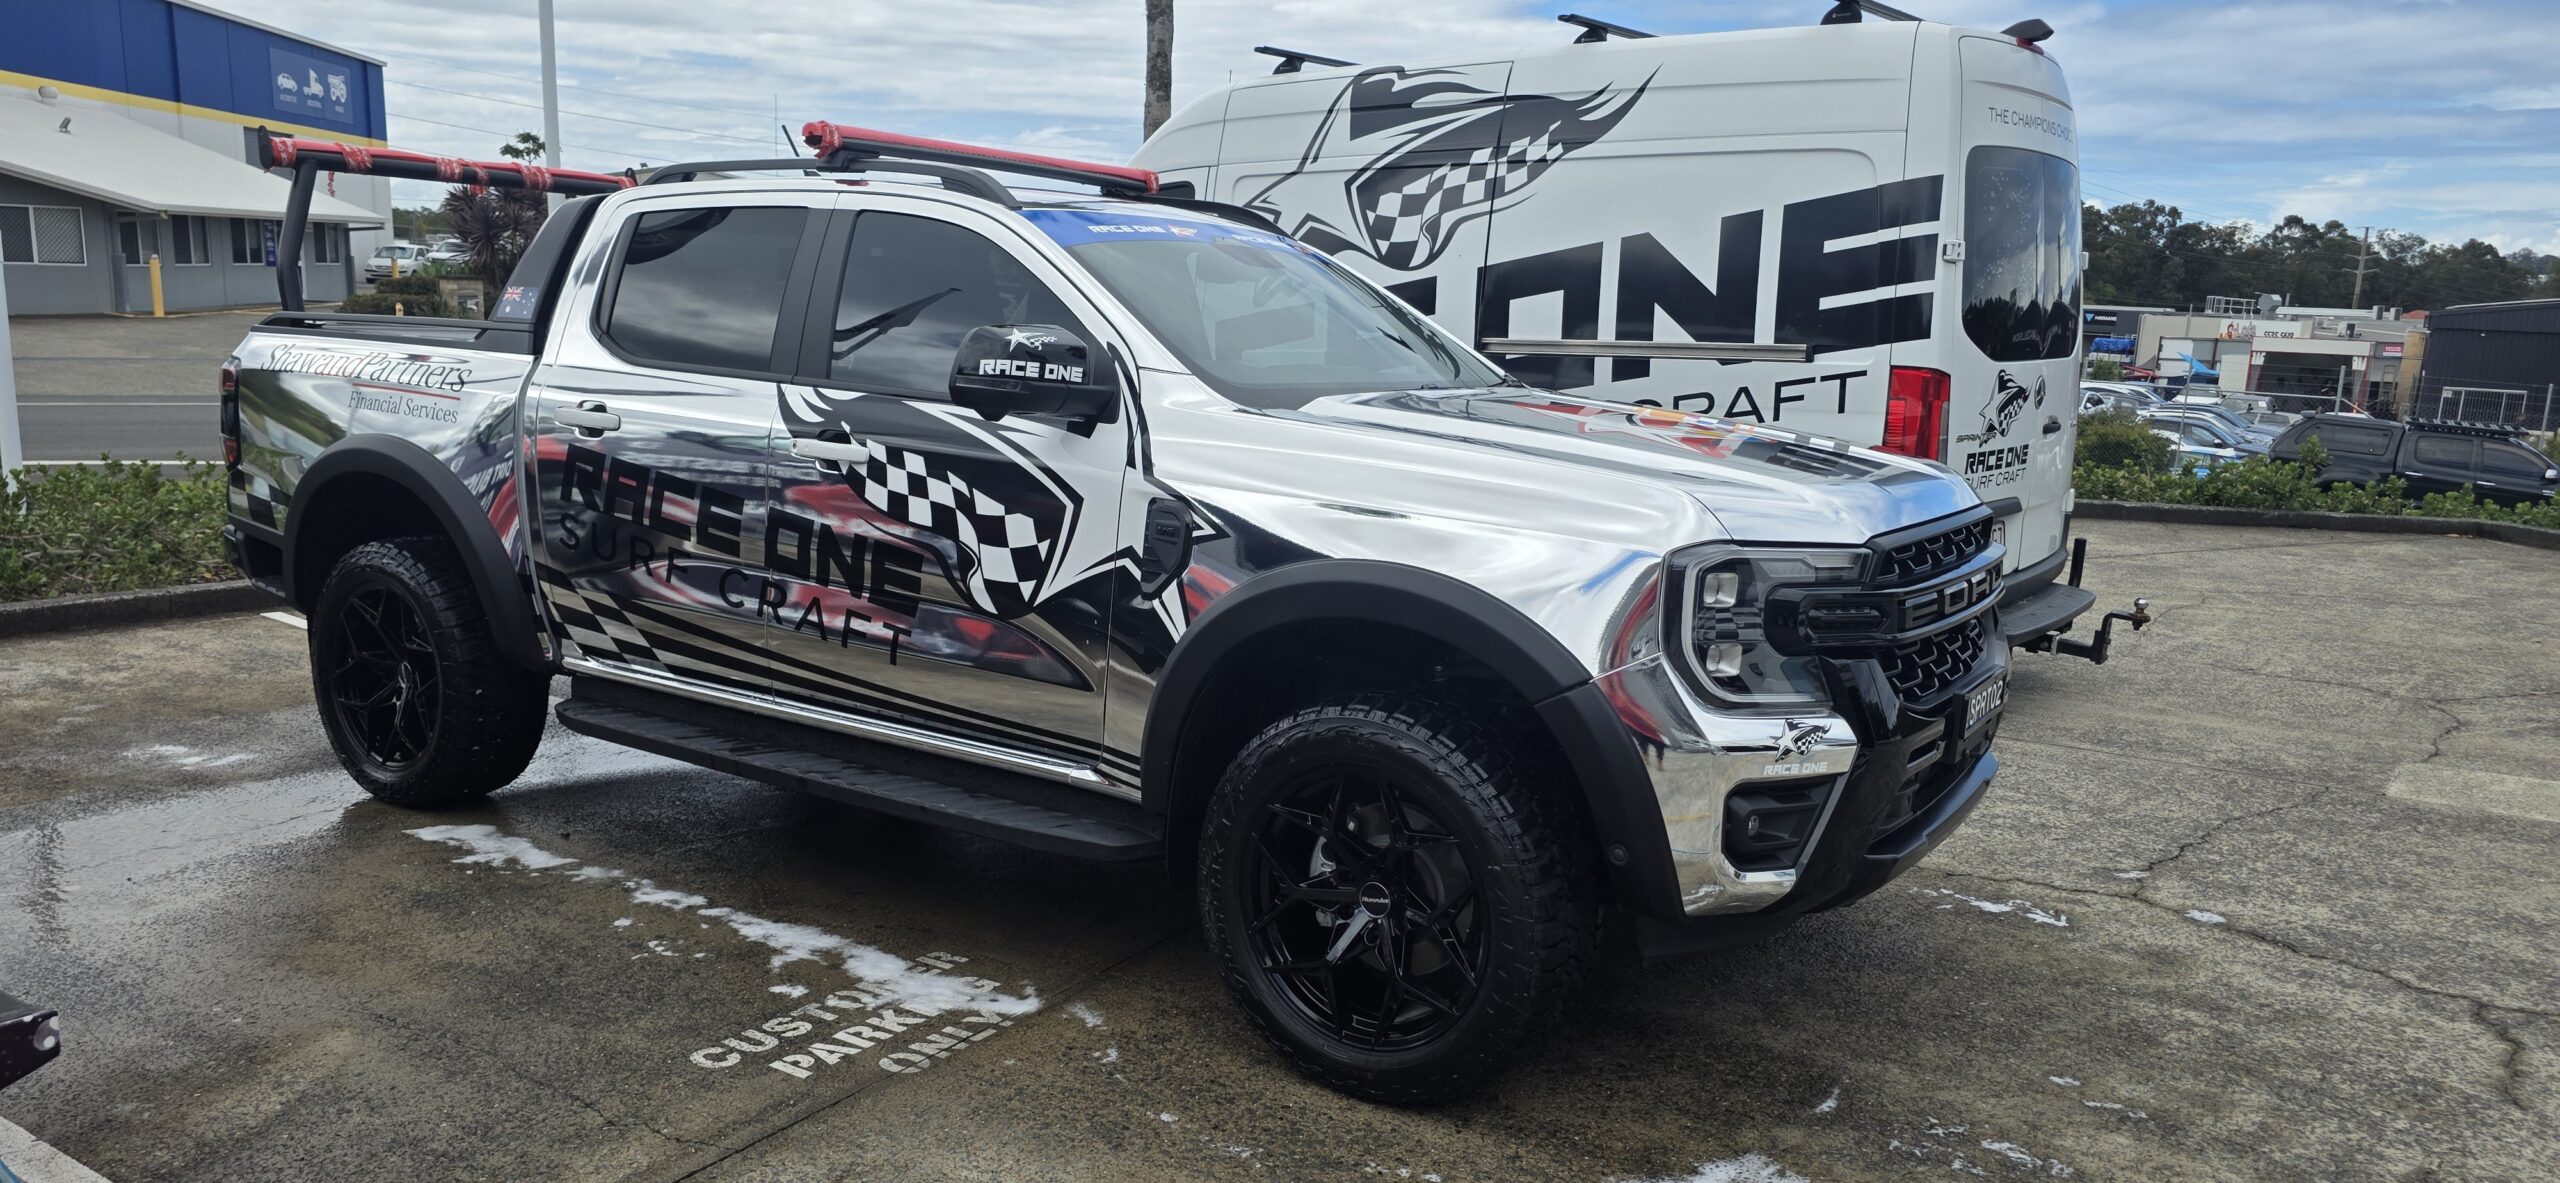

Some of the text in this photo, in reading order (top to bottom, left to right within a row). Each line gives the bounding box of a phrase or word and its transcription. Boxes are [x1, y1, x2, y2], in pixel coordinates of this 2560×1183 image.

[1988, 107, 2009, 124] THE
[2011, 111, 2056, 136] CHAMPIONS
[1088, 225, 1167, 234] RACE ONE
[1477, 174, 1944, 391] ONE
[978, 359, 1083, 383] RACE ONE
[348, 391, 459, 424] Financial Services
[1956, 431, 1997, 443] SPRINTER
[1965, 444, 2029, 475] RACE ONE
[1996, 467, 2026, 486] CRAFT
[560, 443, 924, 618] RACE ONE
[559, 513, 912, 666] SURF CRAFT
[1763, 761, 1828, 776] RACE ONE
[879, 1007, 1016, 1074] ONLY
